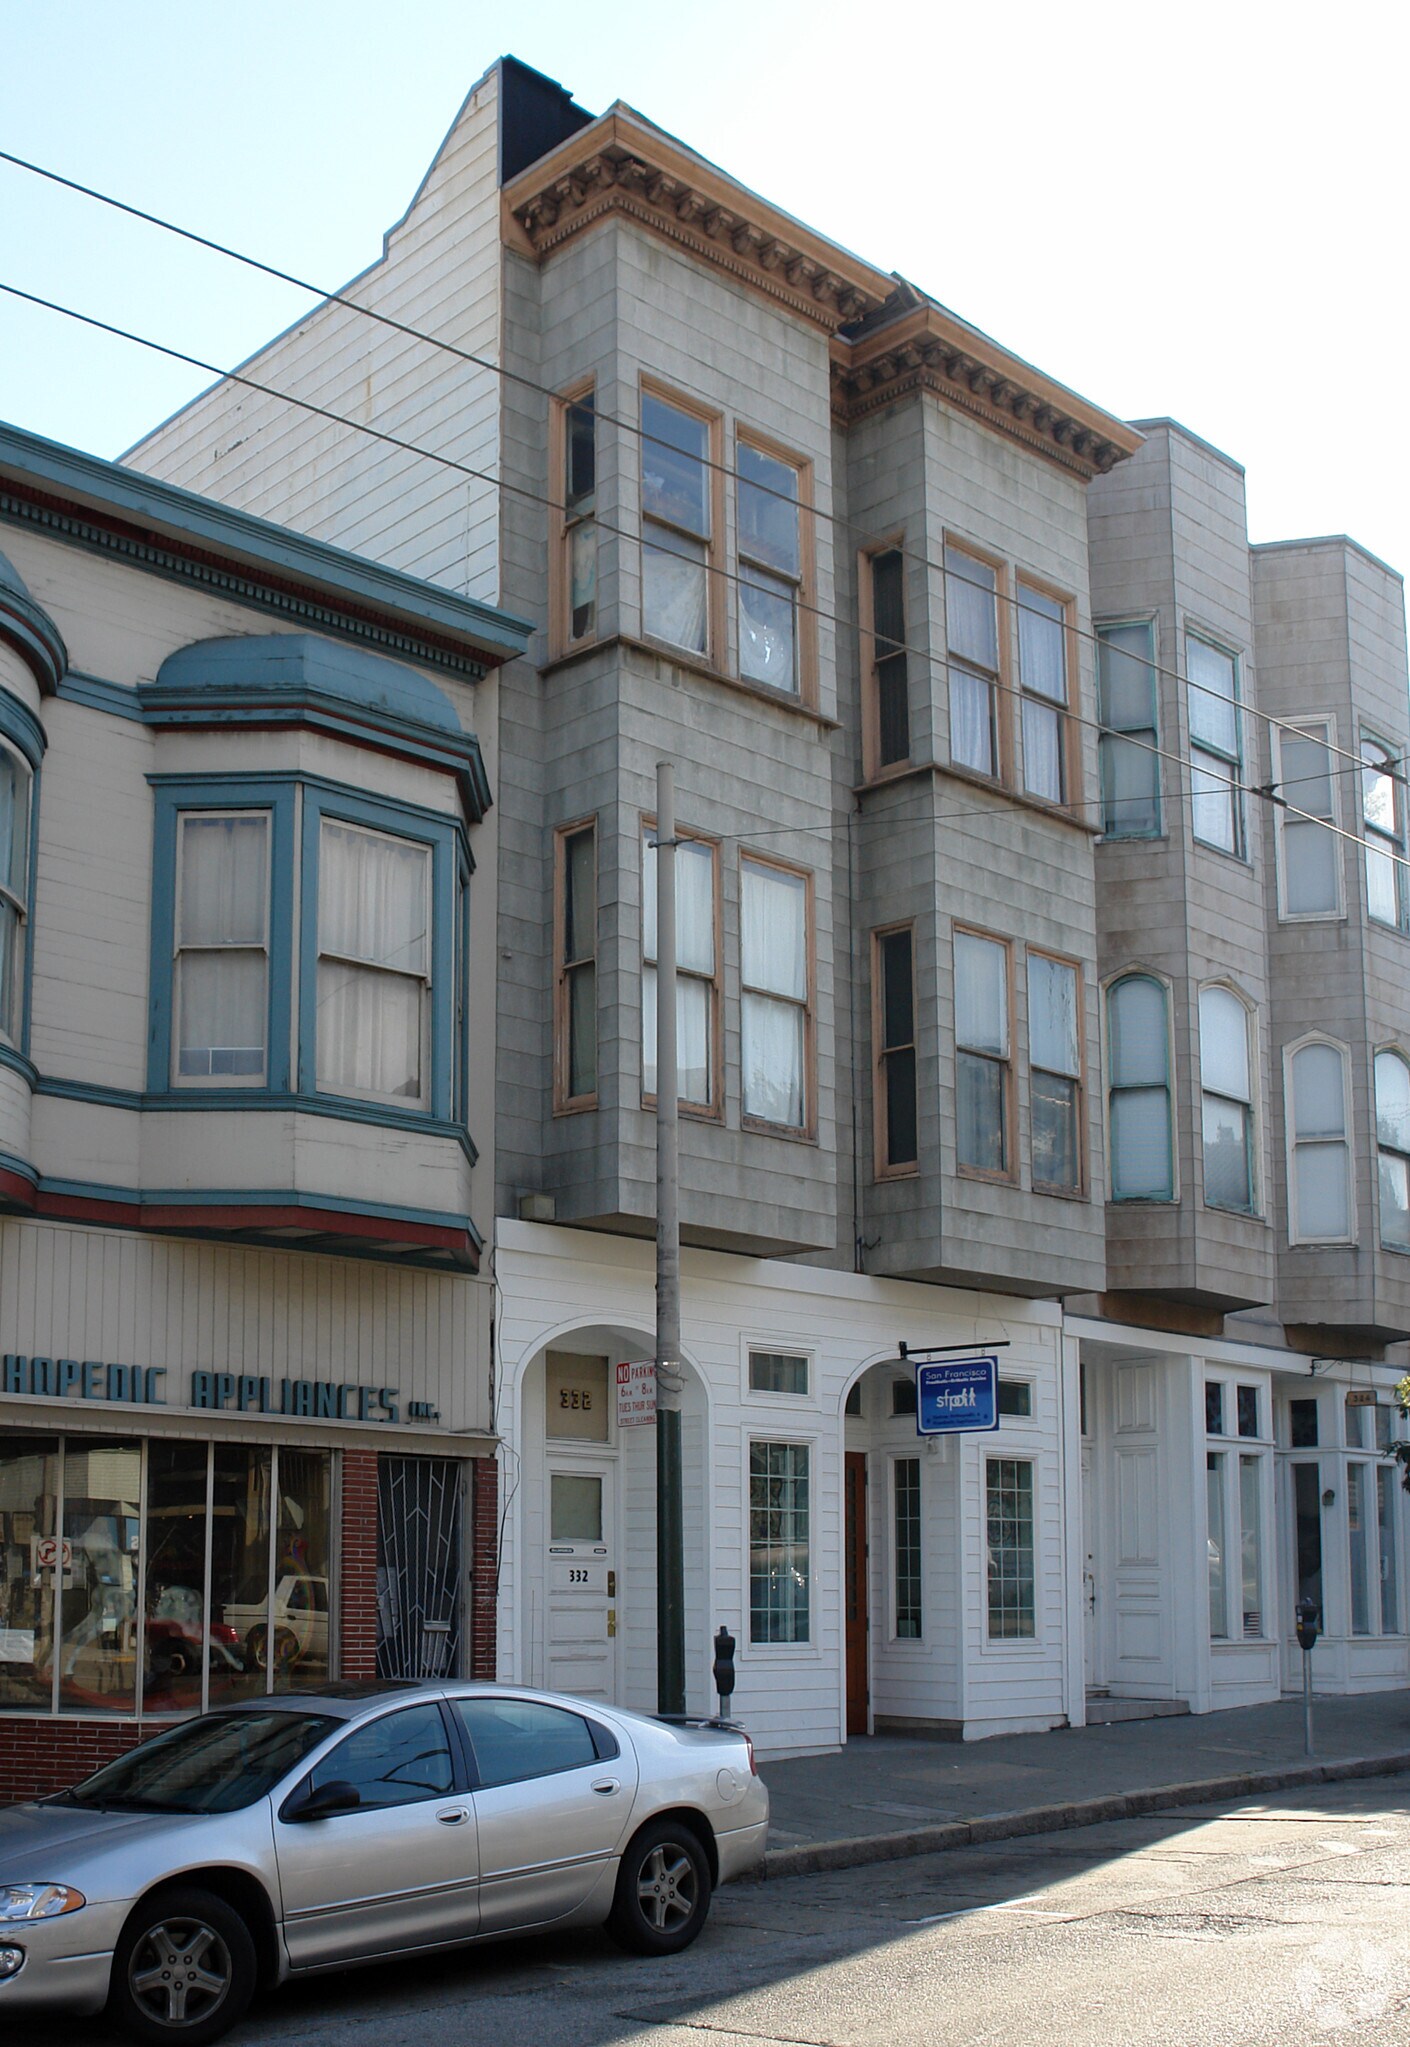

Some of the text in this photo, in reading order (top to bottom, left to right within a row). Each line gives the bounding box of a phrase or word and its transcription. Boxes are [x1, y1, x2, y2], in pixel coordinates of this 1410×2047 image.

[618, 1366, 629, 1383] NO
[926, 1369, 987, 1380] San Francisco
[3, 1353, 168, 1405] HOPEDIC
[191, 1370, 400, 1424] APPLIANCES
[560, 1389, 592, 1410] 332
[619, 1402, 631, 1413] TUES
[632, 1401, 645, 1411] THUR
[569, 1569, 589, 1583] 332
